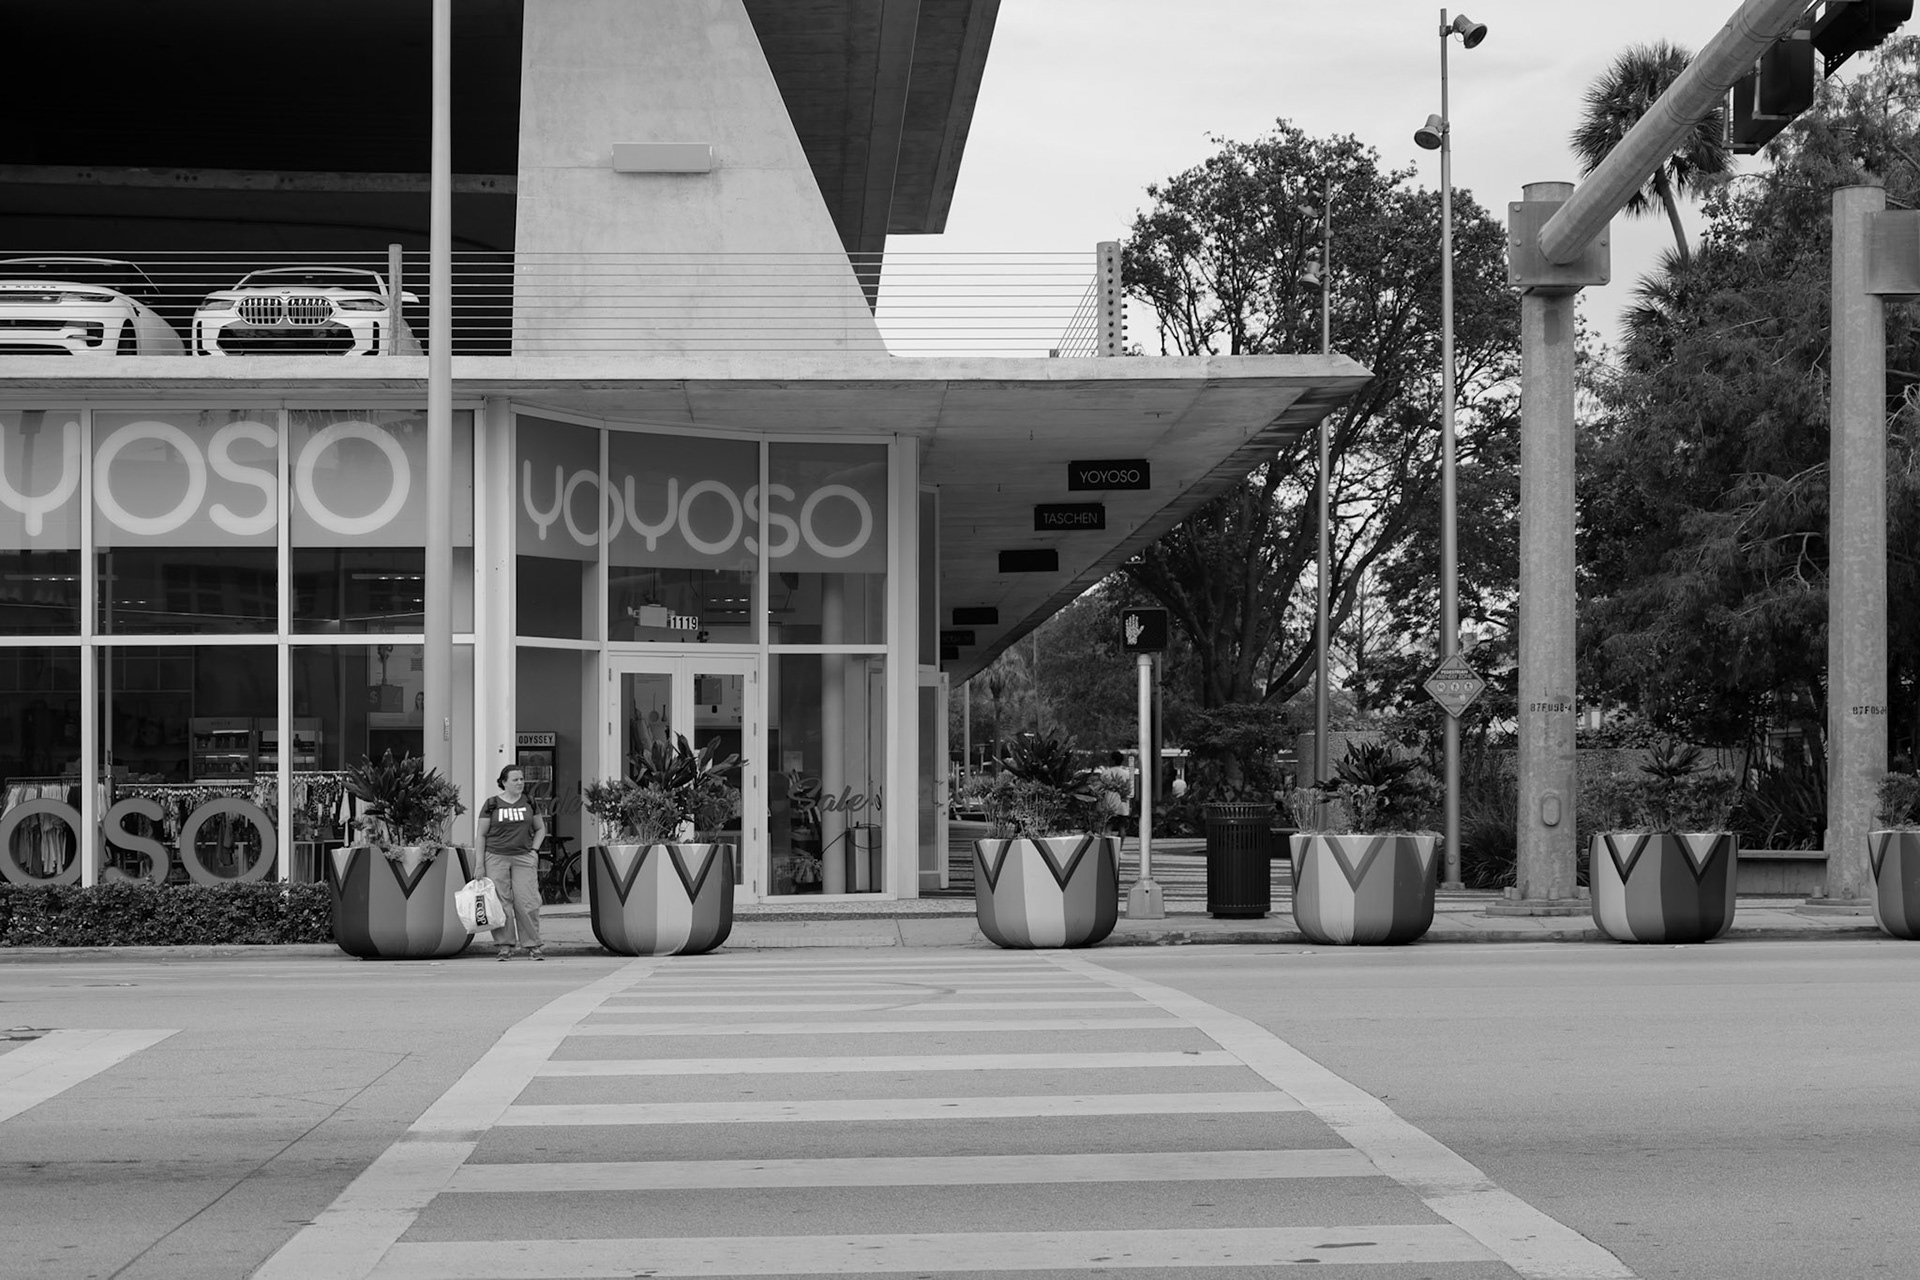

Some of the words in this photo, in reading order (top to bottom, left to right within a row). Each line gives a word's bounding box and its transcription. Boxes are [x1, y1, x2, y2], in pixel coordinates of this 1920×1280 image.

[1079, 469, 1140, 484] YOYOSO
[523, 459, 873, 558] YOYOSO
[1043, 512, 1098, 525] TASCHEN
[672, 616, 697, 630] 1119
[518, 735, 554, 745] ODYSSEY
[788, 777, 869, 813] Sale
[498, 807, 527, 822] MIT
